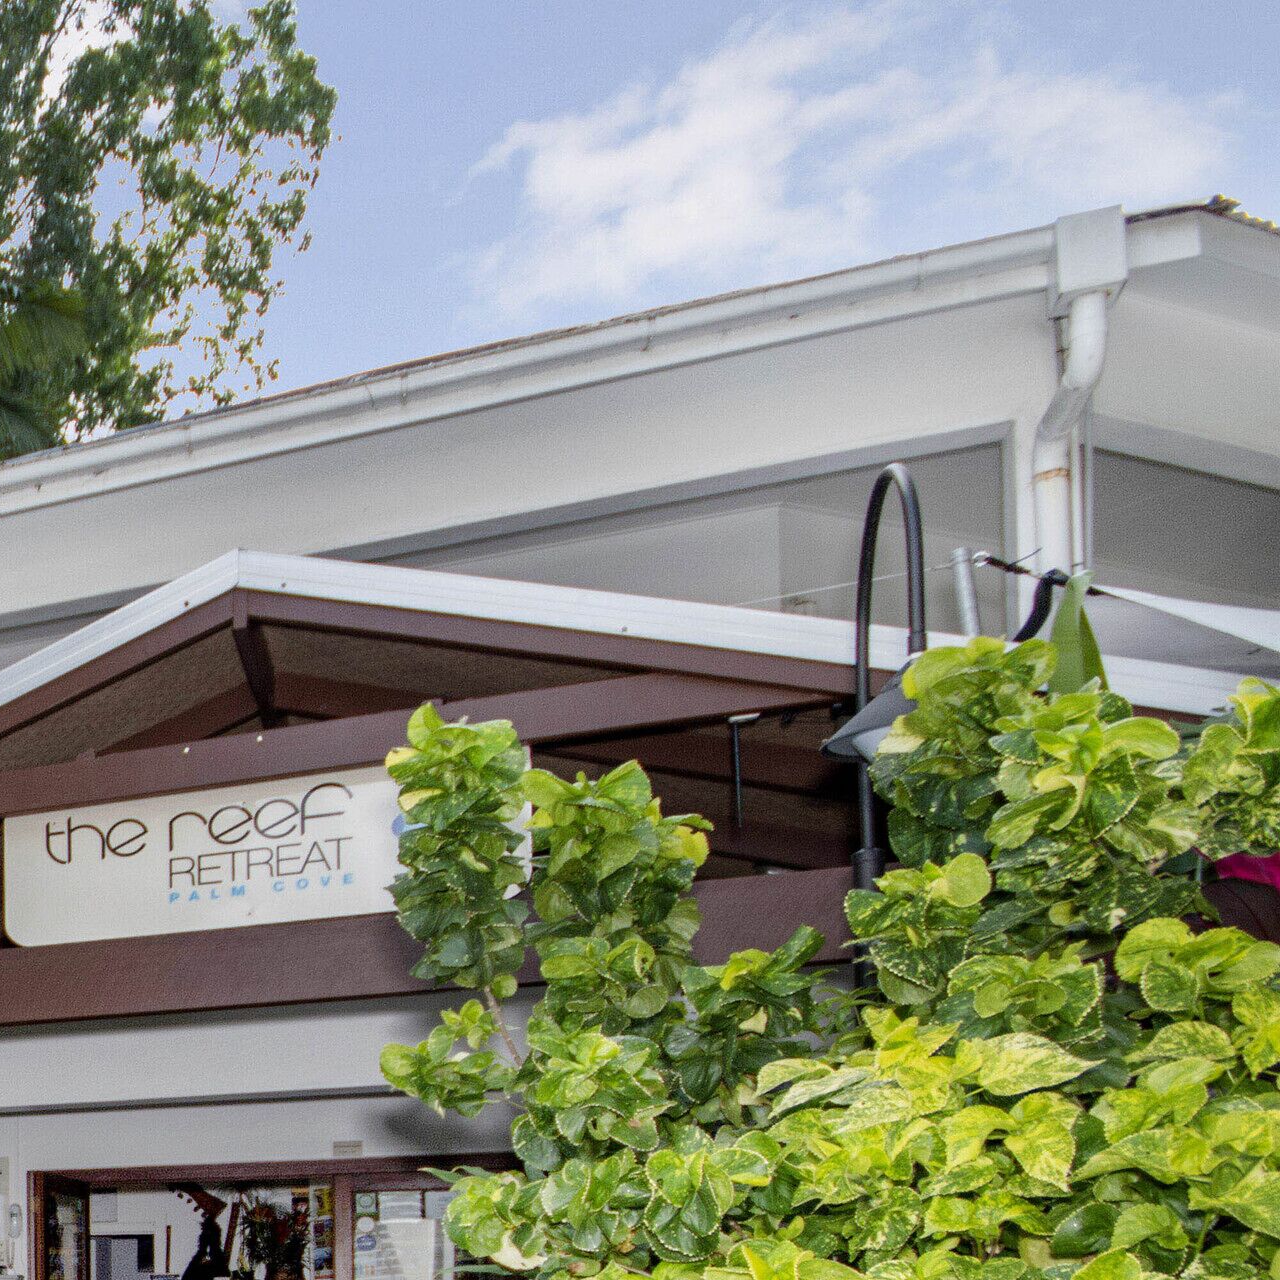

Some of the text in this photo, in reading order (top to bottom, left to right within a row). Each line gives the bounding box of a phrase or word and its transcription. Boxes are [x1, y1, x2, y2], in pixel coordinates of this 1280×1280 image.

[45, 782, 354, 865] the reef
[167, 836, 354, 889] RETREAT
[168, 872, 355, 904] PALM COVE
